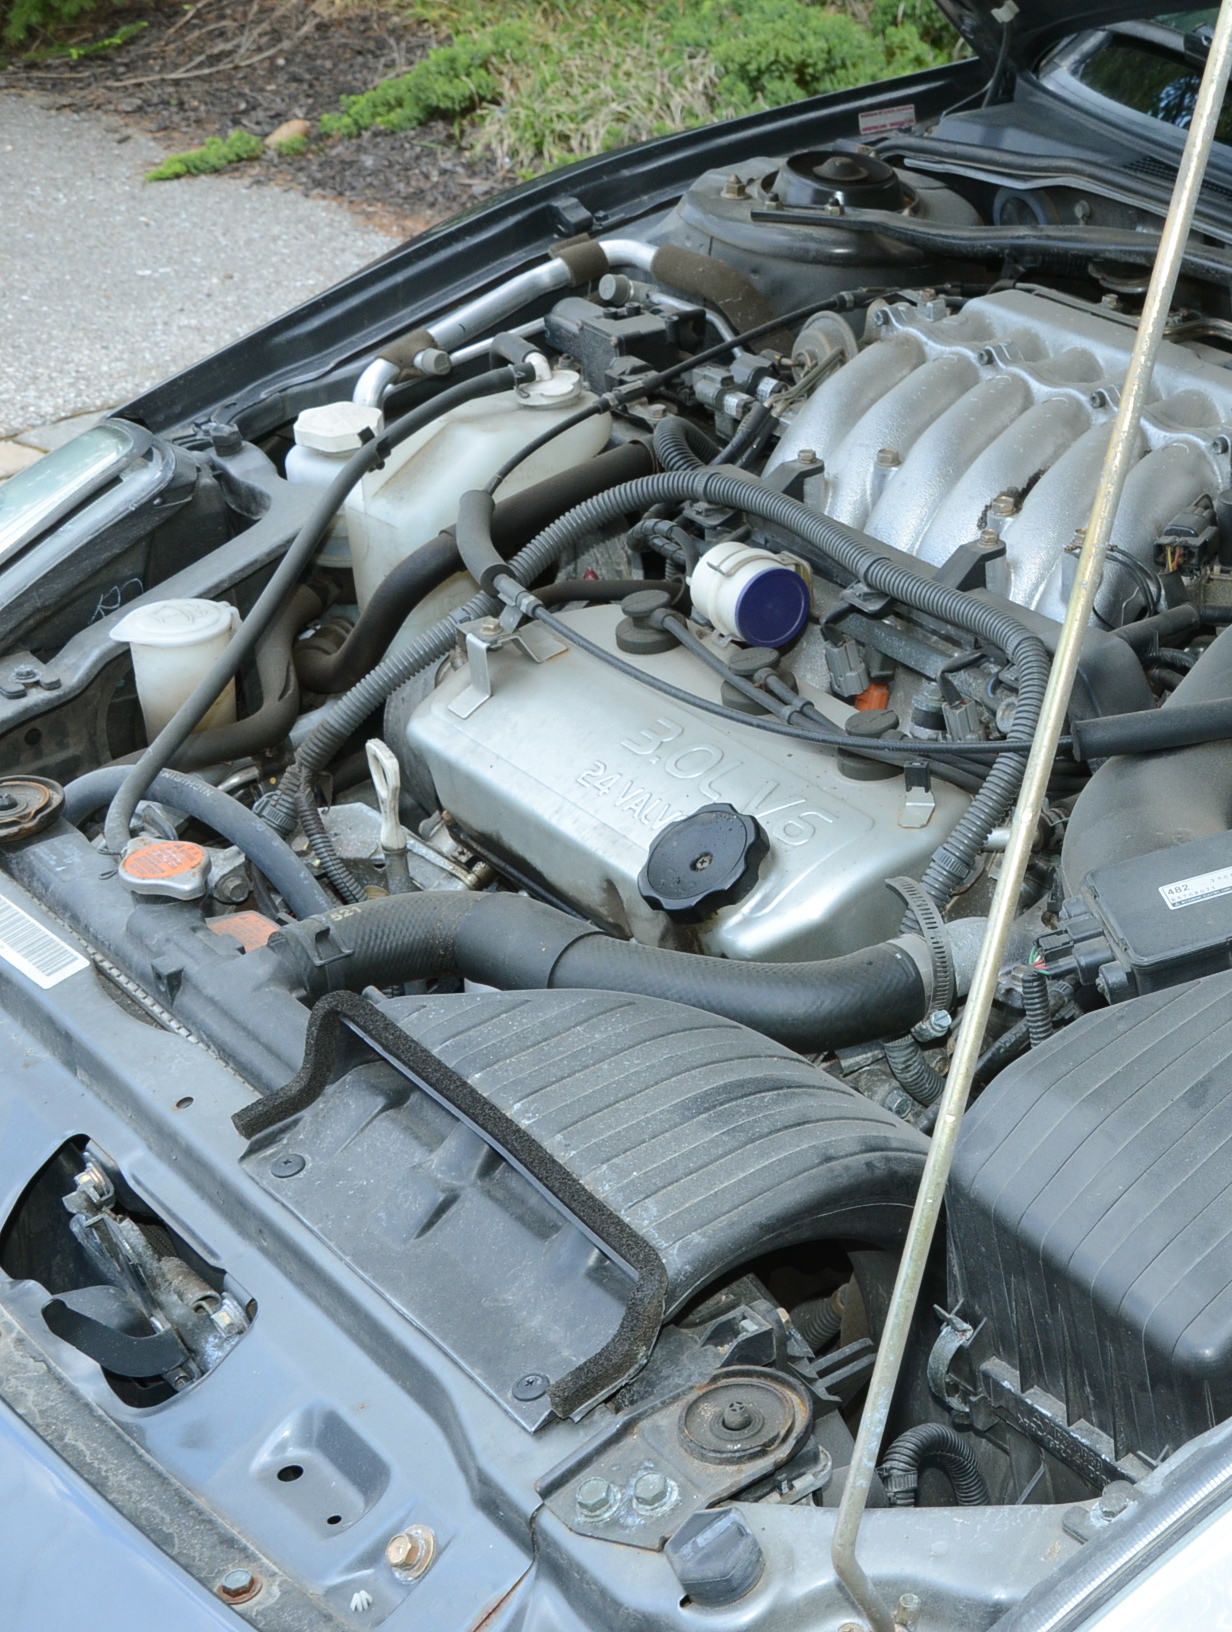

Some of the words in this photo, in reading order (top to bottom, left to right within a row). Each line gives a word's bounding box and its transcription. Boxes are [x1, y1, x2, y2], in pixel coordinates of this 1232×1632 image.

[161, 771, 214, 797] NICHIRIN
[576, 759, 624, 797] 24
[610, 780, 691, 831] VALV
[742, 780, 839, 847] V6
[1167, 884, 1190, 896] 482
[330, 905, 362, 921] 521
